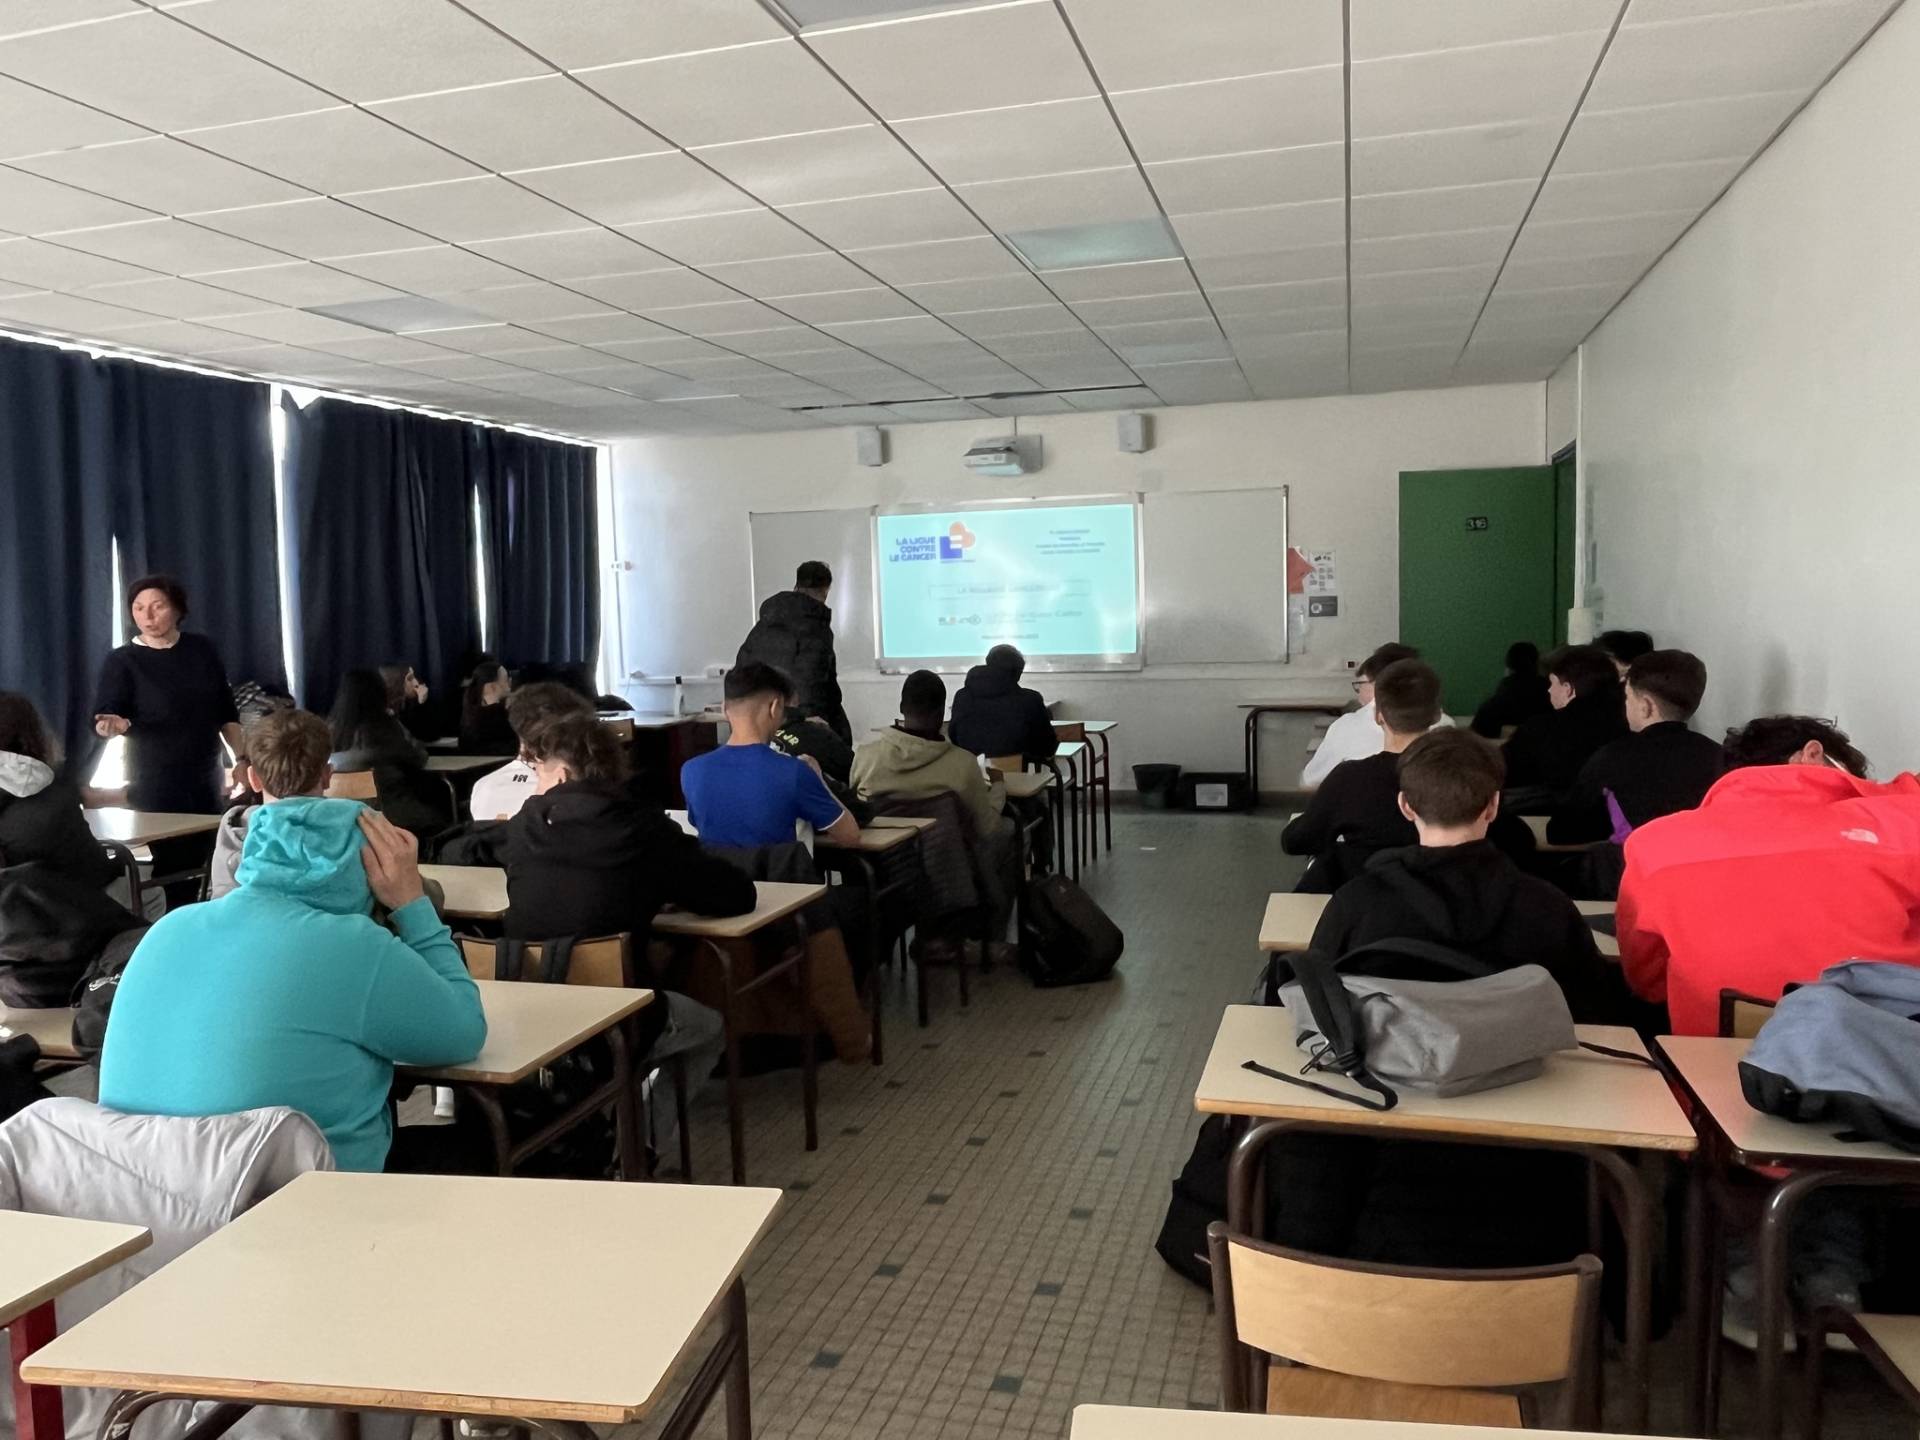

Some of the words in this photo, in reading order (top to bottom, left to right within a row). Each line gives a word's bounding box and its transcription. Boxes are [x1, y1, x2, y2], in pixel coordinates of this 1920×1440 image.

[896, 537, 909, 546] LA
[909, 536, 936, 545] LIGUE
[900, 545, 936, 553] CONTRE
[889, 554, 900, 562] LE
[901, 553, 936, 561] CANCER
